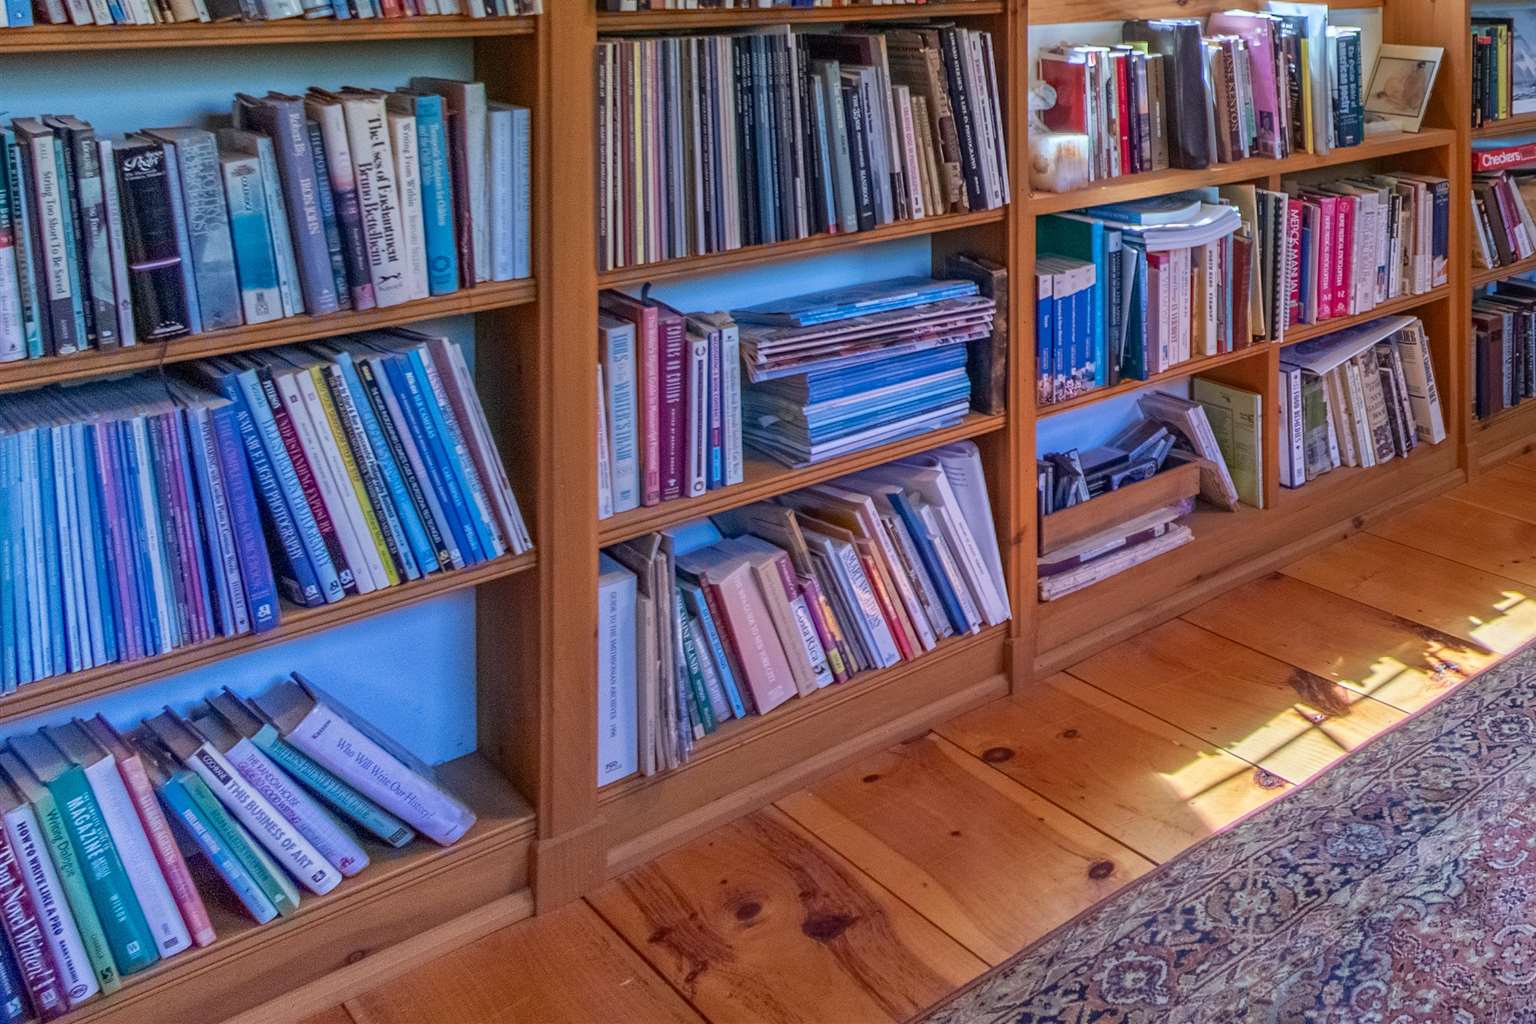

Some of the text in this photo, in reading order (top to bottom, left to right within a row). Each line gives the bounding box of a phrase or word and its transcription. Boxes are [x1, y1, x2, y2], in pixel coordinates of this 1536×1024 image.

[1347, 46, 1355, 57] The
[1337, 42, 1350, 113] american poetry
[1348, 84, 1356, 99] Bible
[1227, 81, 1240, 131] KENYON
[400, 122, 413, 153] Writing
[1482, 151, 1521, 166] Checkers
[288, 111, 319, 235] Robert Bly IRON JOHN
[367, 113, 401, 262] The Uses of Enchantment
[404, 156, 414, 176] From
[357, 161, 386, 267] Bruno Bettelheim
[406, 179, 417, 207] Within
[38, 170, 67, 293] String Too Short To Be Saved
[1289, 209, 1299, 244] MERCK
[405, 370, 419, 394] Nikon
[418, 405, 436, 439] CAMERAS
[262, 379, 281, 409] PETERSON
[275, 410, 314, 489] UNDERSTANDING
[252, 456, 278, 492] LIGHT
[365, 459, 385, 494] Photography
[380, 494, 394, 518] Business
[264, 488, 307, 562] PHOTOGRAPHY
[609, 591, 617, 612] GUIDE
[609, 614, 617, 622] TO
[609, 624, 617, 638] THE
[792, 604, 822, 662] Costa Rica
[609, 639, 617, 685] SMITHSONIAN
[609, 686, 617, 719] ARCHIVES
[334, 736, 357, 758] Who
[353, 750, 375, 771] Will
[366, 761, 394, 787] Write
[387, 779, 409, 800] Our
[42, 806, 67, 844] Writing
[64, 793, 105, 860] MAGAZINE
[225, 778, 251, 805] THIS
[243, 798, 286, 844] BUSINESS
[279, 836, 296, 853] OF
[288, 845, 314, 872] ART
[14, 820, 64, 936] HOW TO WRITE LIKE A PRO
[53, 839, 79, 878] Dialogue
[6, 882, 36, 928] Novel
[108, 893, 128, 922] WILSON
[17, 925, 53, 979] Written!
